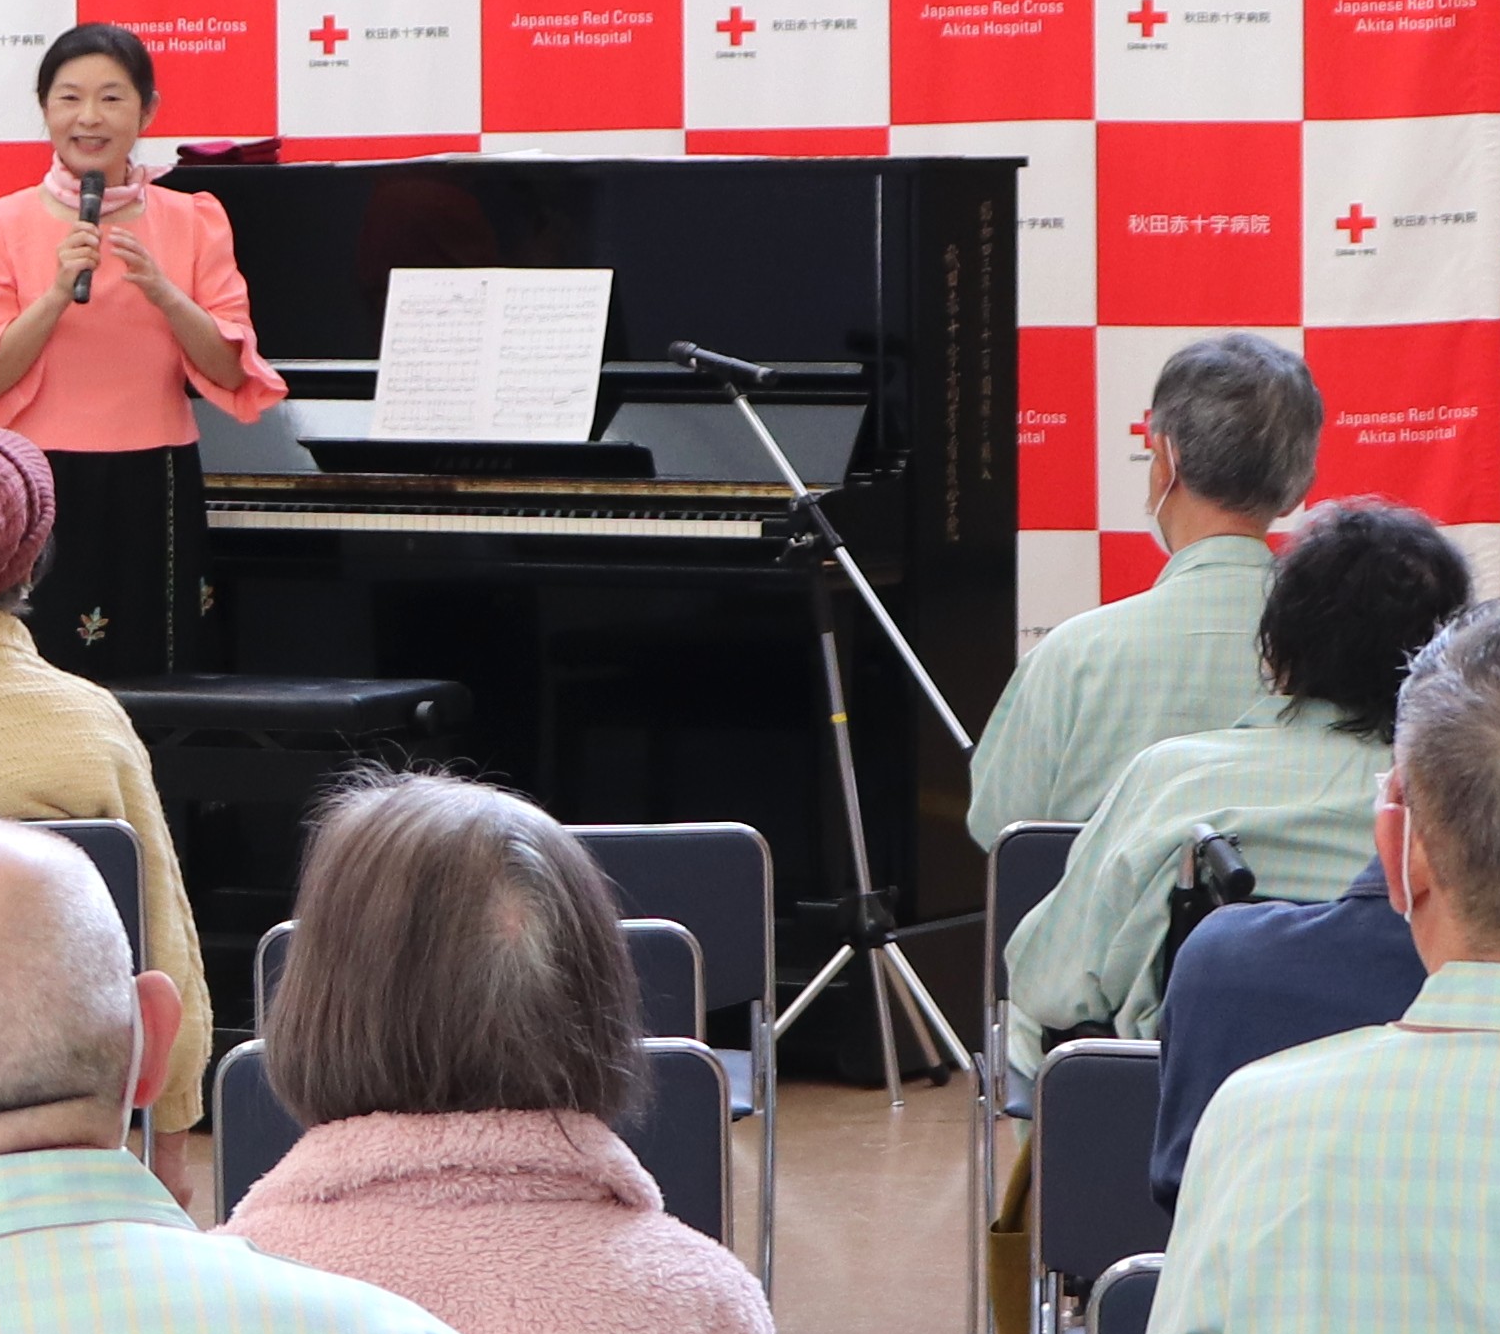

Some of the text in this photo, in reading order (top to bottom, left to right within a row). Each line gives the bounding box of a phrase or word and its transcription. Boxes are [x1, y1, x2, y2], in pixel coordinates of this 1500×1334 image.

[920, 0, 1065, 20] Japanese Red Cross
[1184, 11, 1272, 24] 秋田赤十字病院
[177, 18, 204, 32] Red
[207, 17, 248, 32] Cross
[511, 9, 654, 29] Japanese Red Cross
[772, 18, 858, 32] 秋田赤十字病院
[941, 19, 1043, 36] Akita Hospital
[1355, 14, 1457, 33] Akita Hospital
[364, 26, 450, 40] 秋田赤十字病院
[532, 29, 632, 46] Akita Hospital
[169, 37, 226, 54] Hospital
[1128, 213, 1271, 235] 秋田赤十字病院
[1392, 211, 1478, 228] 秋田赤十字病院
[1026, 410, 1067, 425] Cross
[1336, 405, 1478, 427] Japanese Red Cross
[1357, 426, 1457, 445] Akita Hospital
